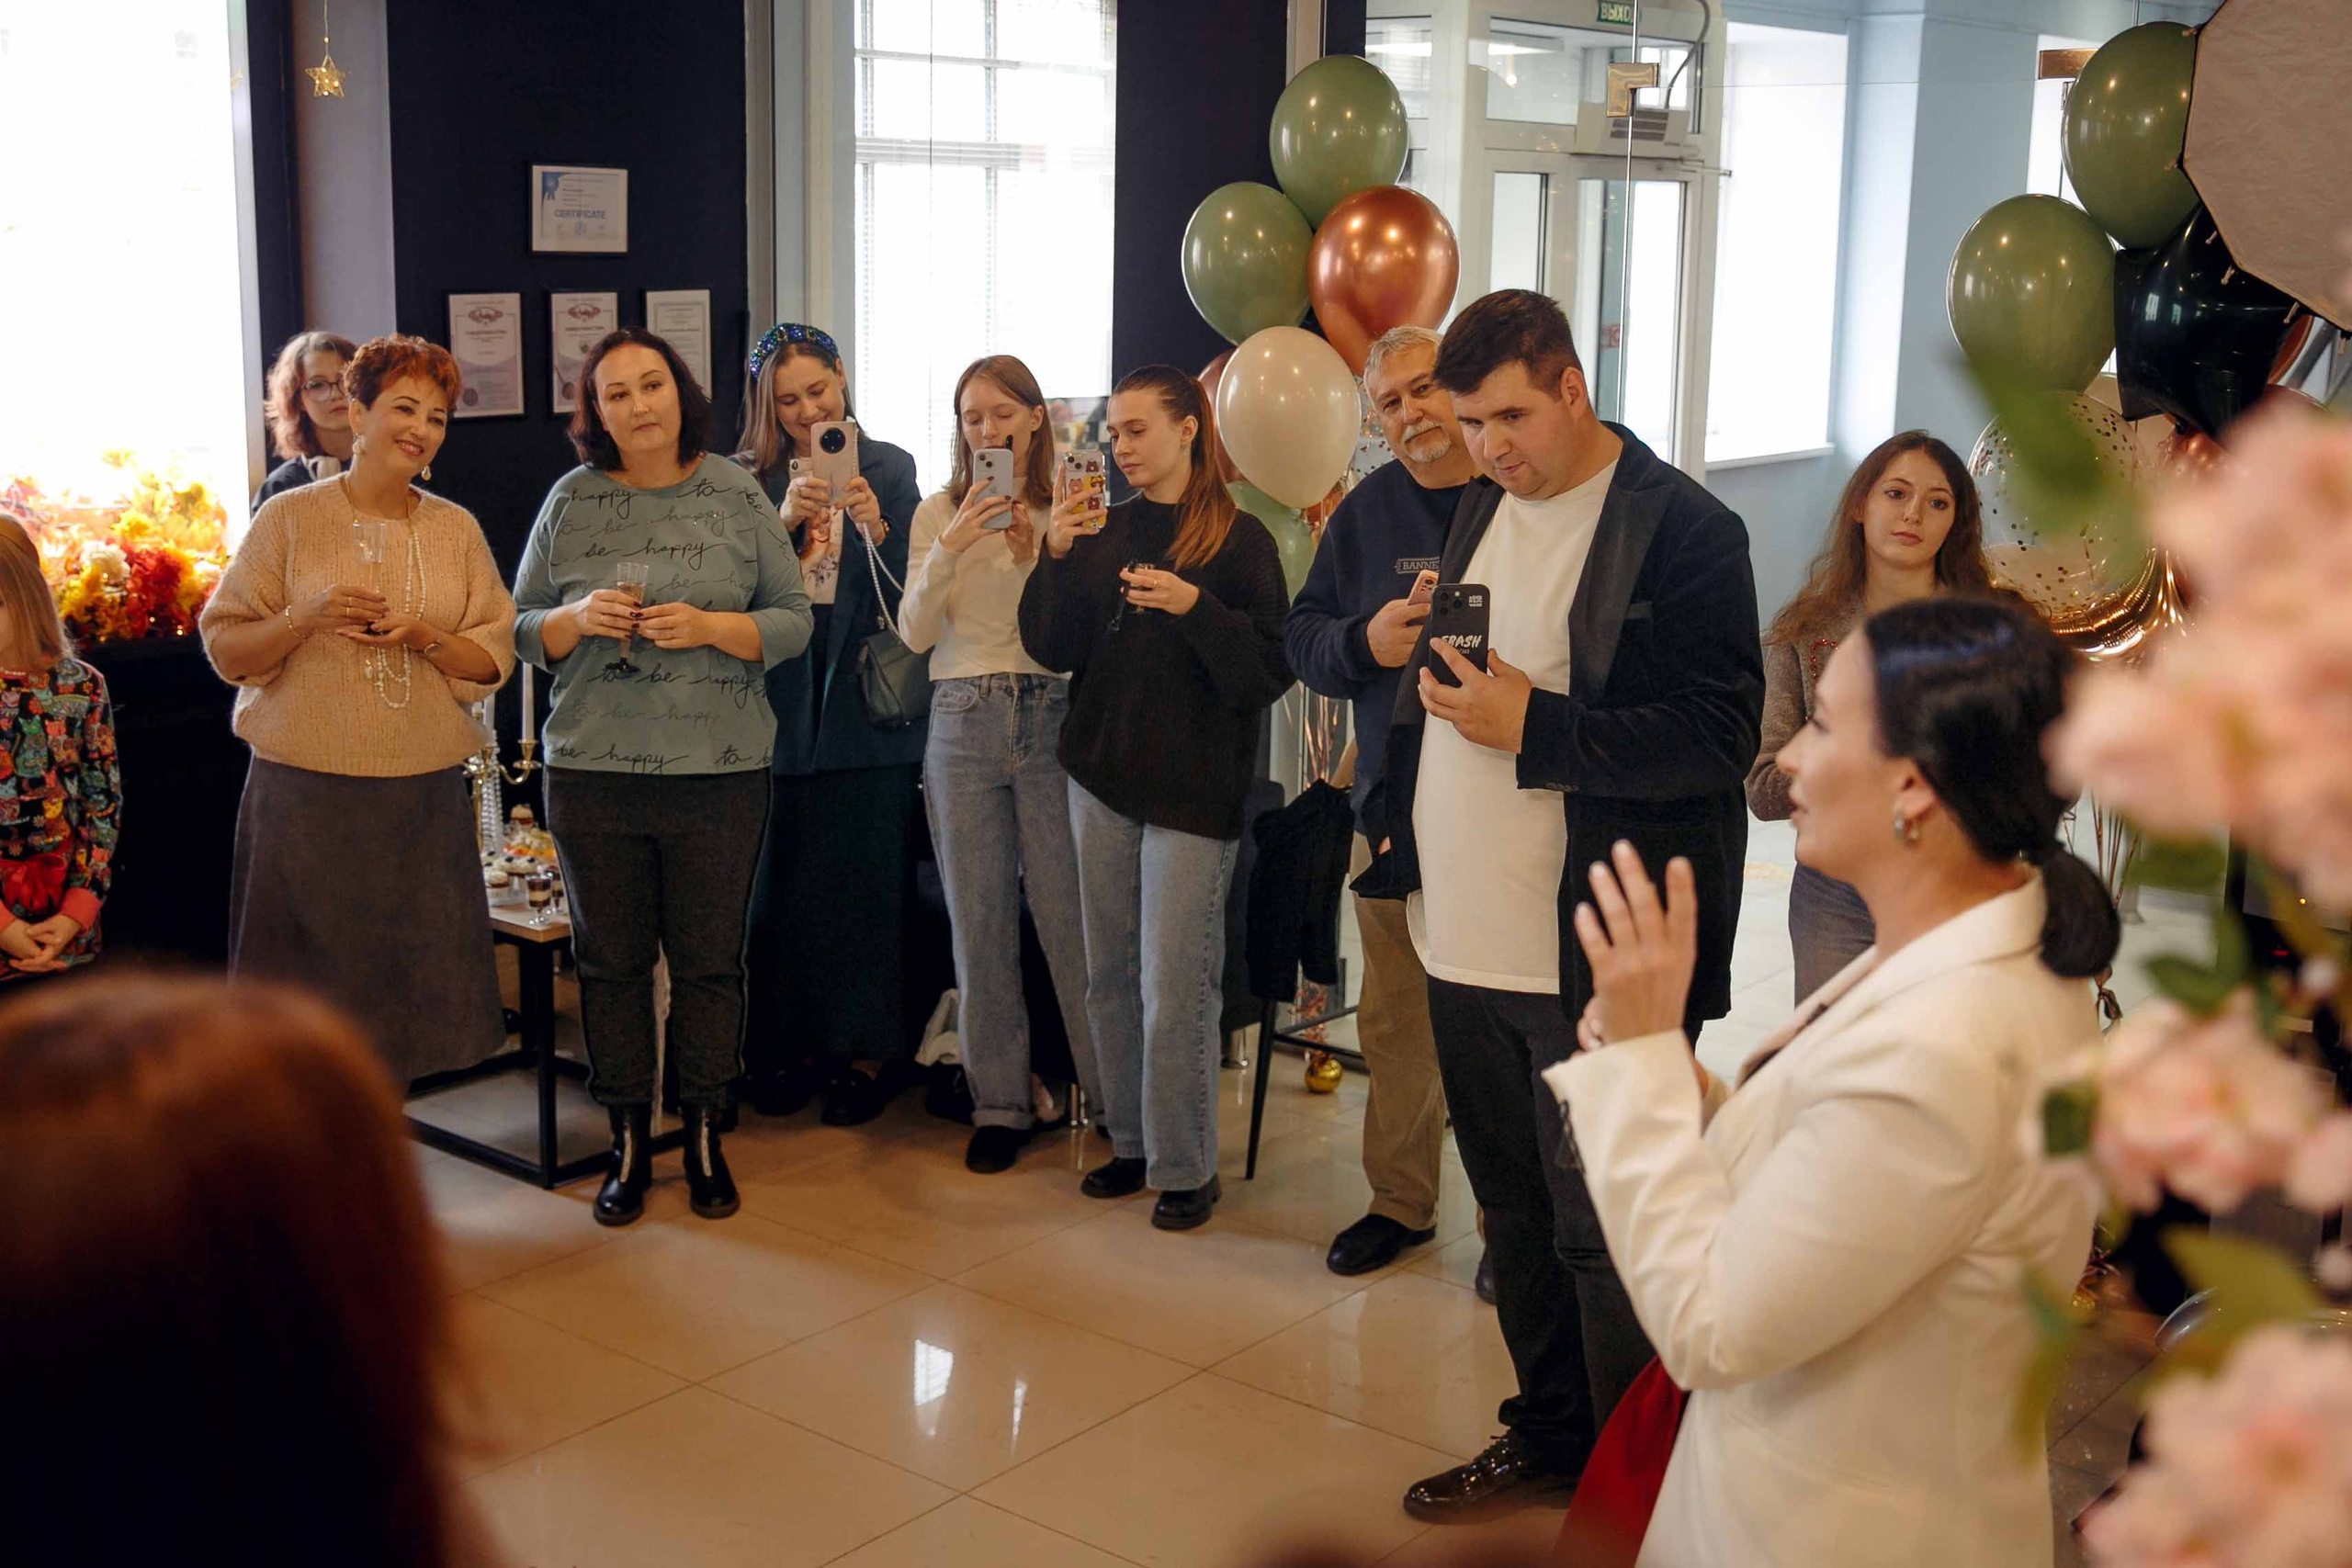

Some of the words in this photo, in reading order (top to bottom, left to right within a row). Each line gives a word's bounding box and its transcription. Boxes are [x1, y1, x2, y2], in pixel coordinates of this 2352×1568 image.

[1600, 2, 1634, 22] ВЫХО
[554, 209, 606, 220] CERTIFICATE
[571, 487, 639, 520] happy
[589, 518, 639, 539] be
[650, 505, 741, 536] happy
[573, 542, 622, 561] be
[622, 536, 729, 571] happy
[1402, 560, 1440, 570] BANNE
[655, 572, 706, 593] be
[635, 662, 686, 683] be
[552, 737, 589, 758] be
[590, 742, 689, 773] happy
[714, 744, 752, 765] to
